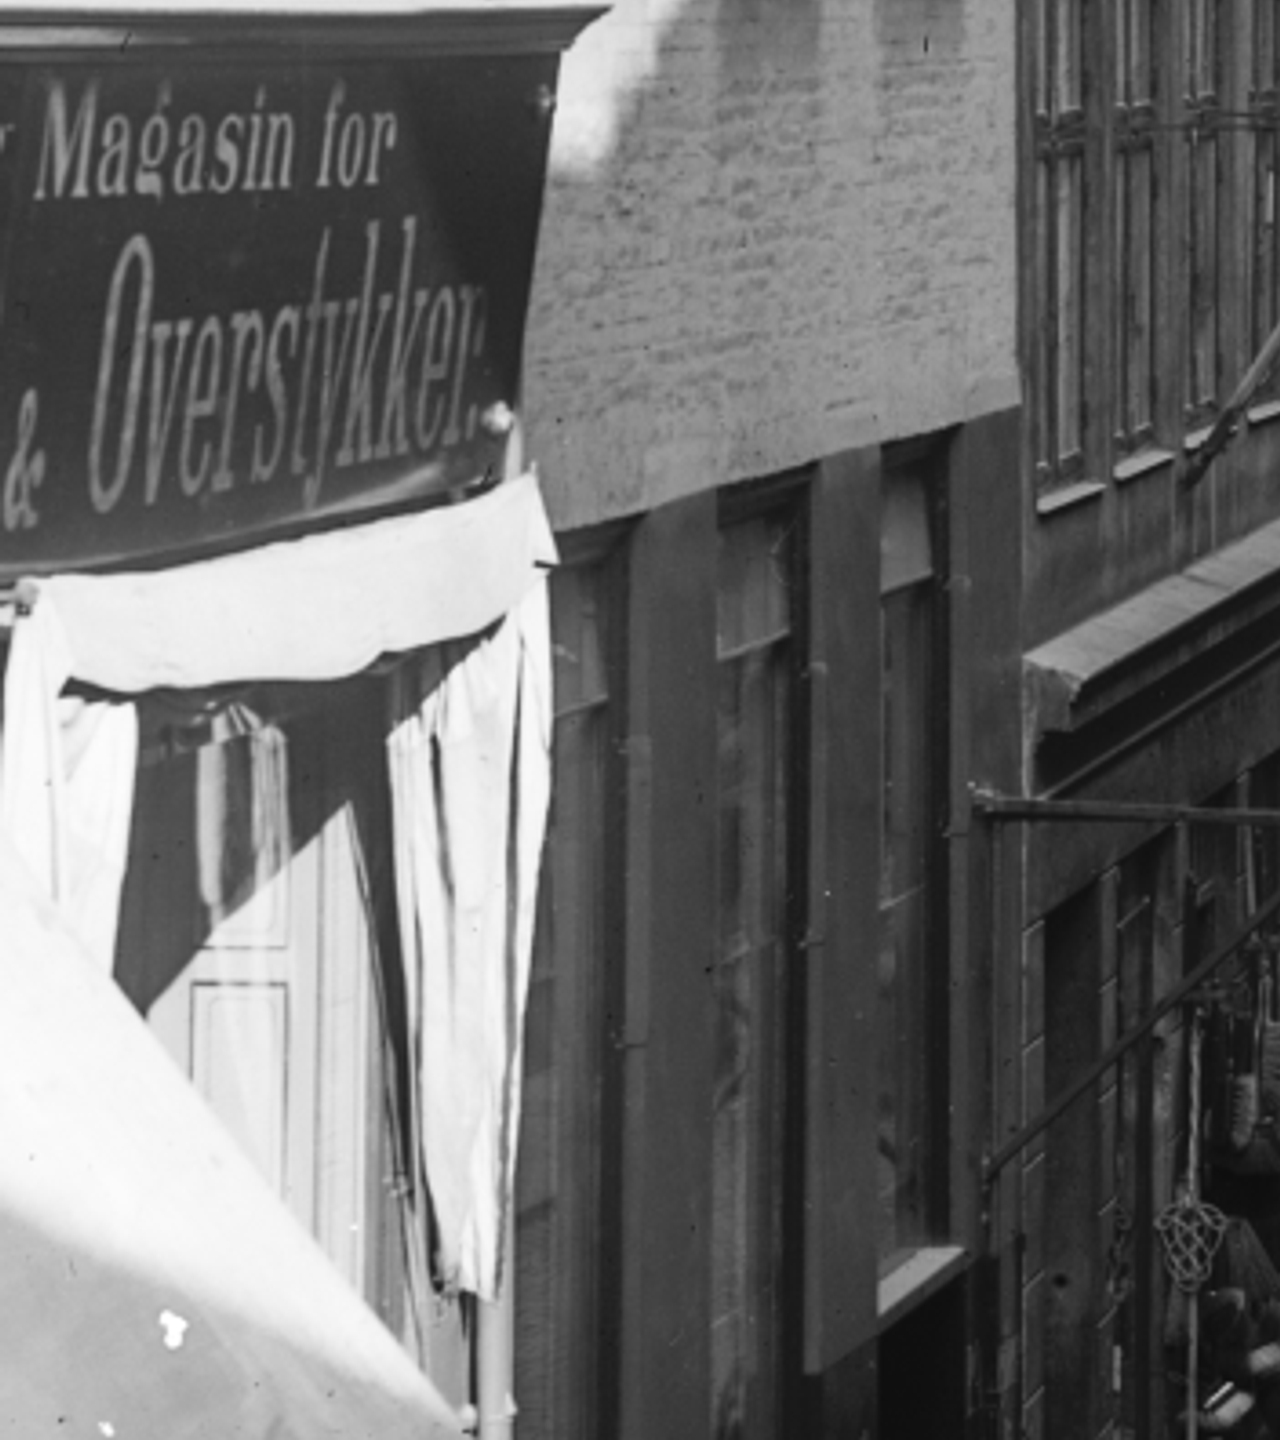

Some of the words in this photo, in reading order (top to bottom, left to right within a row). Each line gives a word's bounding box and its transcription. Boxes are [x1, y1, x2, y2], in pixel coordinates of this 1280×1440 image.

[33, 77, 297, 202] Magasin
[315, 78, 397, 188] for
[4, 388, 46, 531] &
